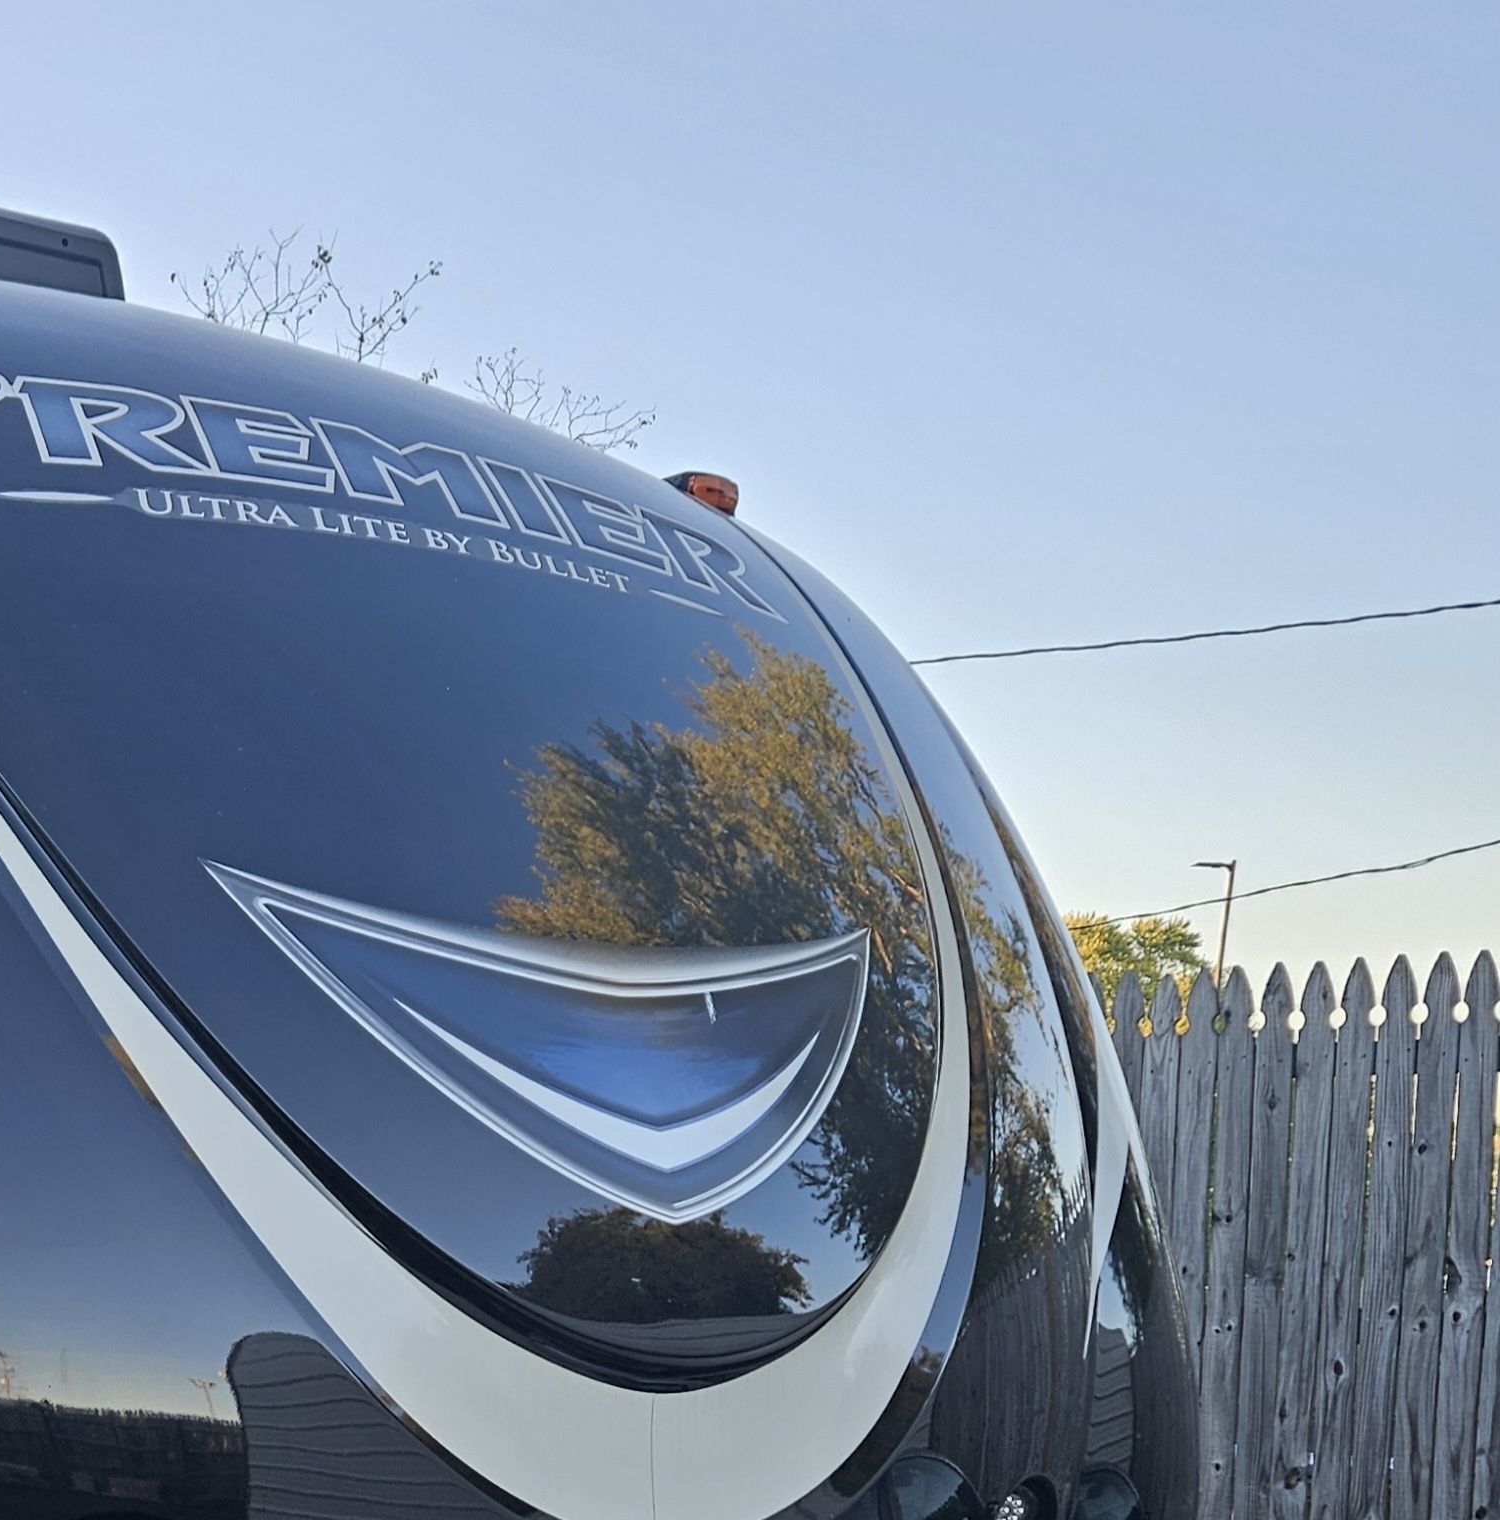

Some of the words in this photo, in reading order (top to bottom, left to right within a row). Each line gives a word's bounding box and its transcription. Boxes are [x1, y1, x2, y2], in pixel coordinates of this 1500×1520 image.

[133, 487, 300, 528] ULTRA
[309, 506, 411, 545] LITE
[421, 526, 472, 555] BY
[483, 537, 631, 593] BULLET
